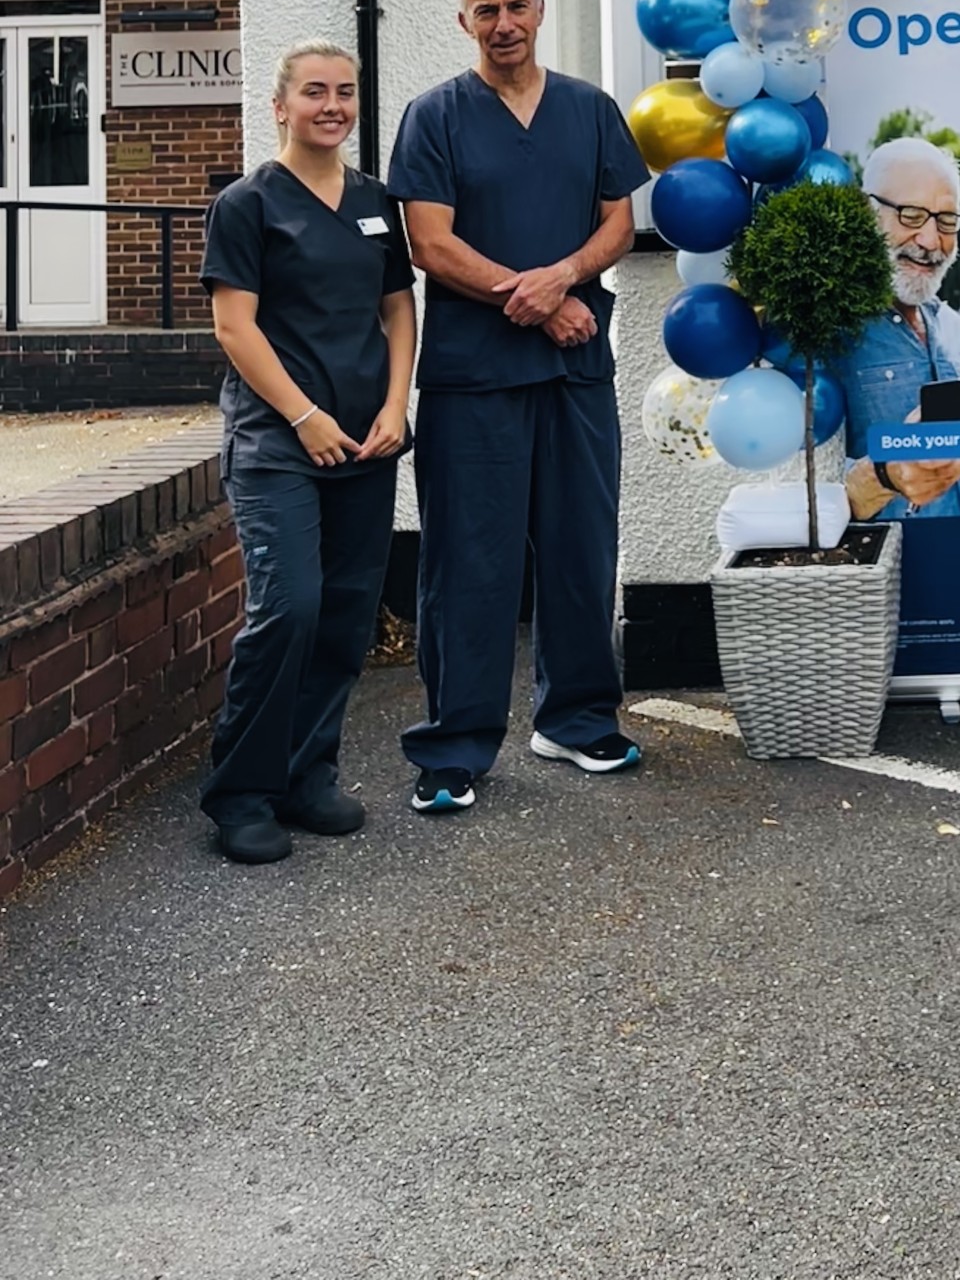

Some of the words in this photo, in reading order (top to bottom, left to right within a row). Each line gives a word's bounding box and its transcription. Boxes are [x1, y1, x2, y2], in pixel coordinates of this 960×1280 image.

[120, 53, 128, 77] THE
[131, 48, 243, 78] CLINIC
[881, 434, 922, 449] Book
[925, 434, 960, 450] your
